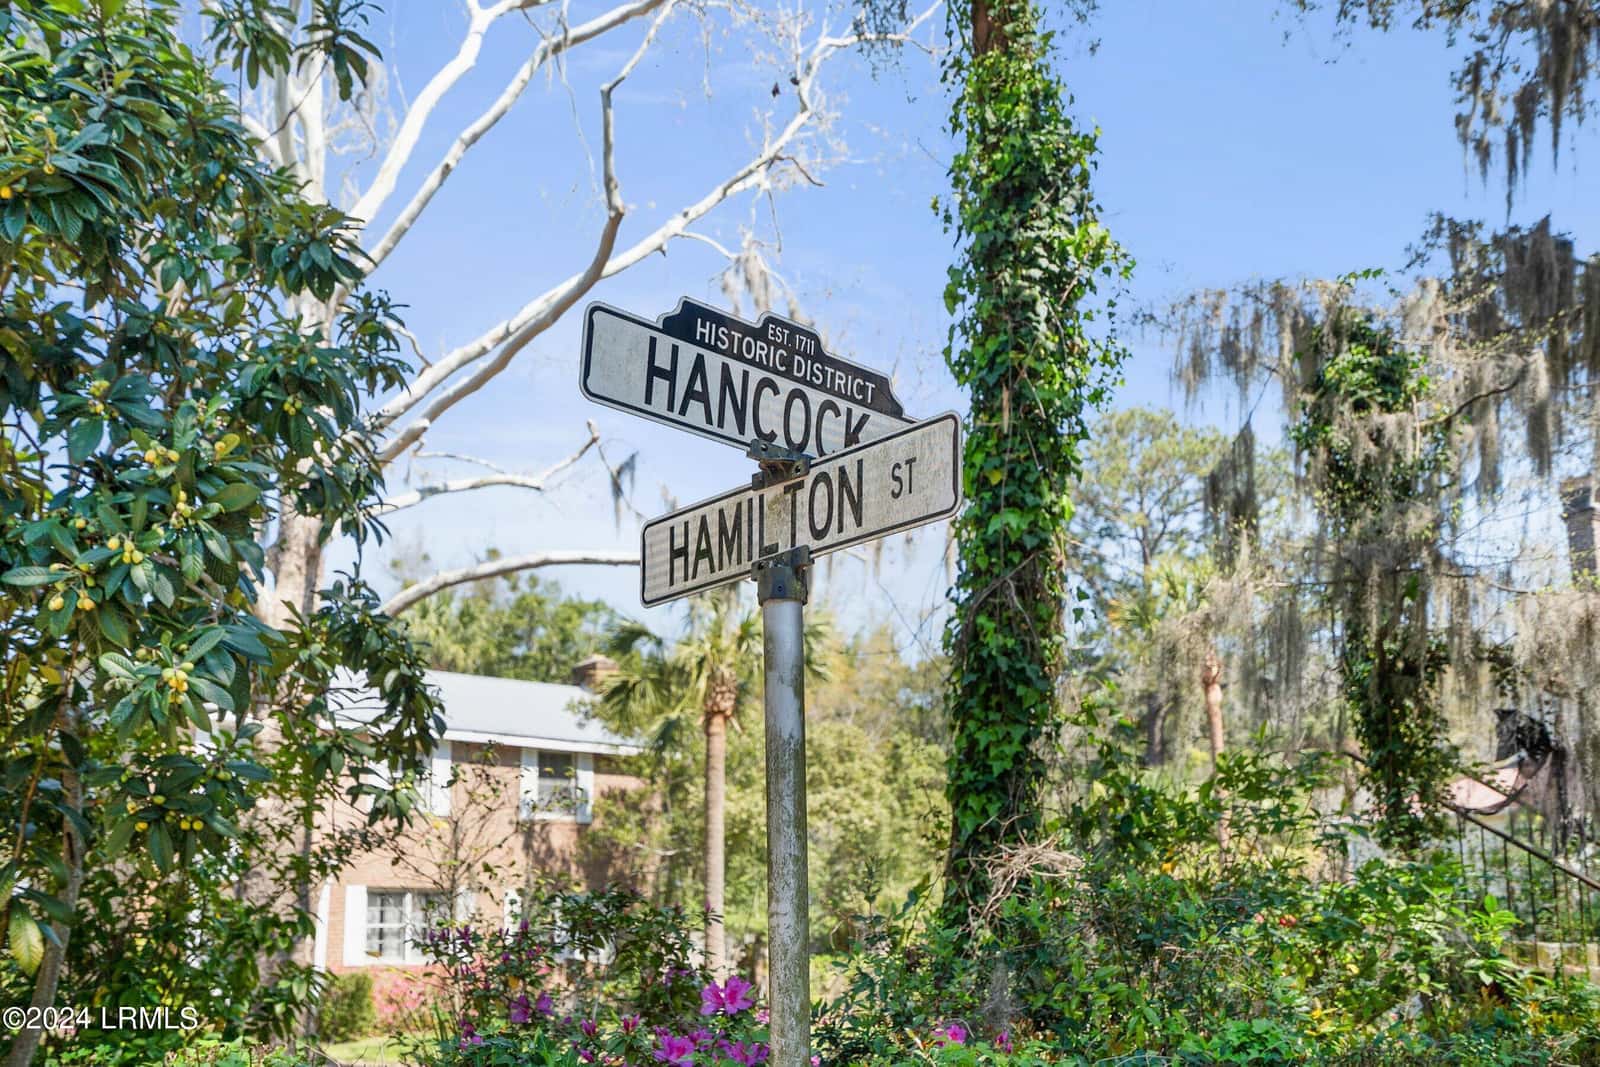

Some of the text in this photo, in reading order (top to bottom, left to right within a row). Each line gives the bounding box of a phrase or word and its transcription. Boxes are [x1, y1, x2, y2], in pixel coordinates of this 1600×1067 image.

[696, 317, 876, 404] HISTORIC DISTRICT
[768, 324, 815, 355] EST. 1711
[644, 336, 871, 457] HANCOCK
[668, 456, 917, 587] HAMILTON ST
